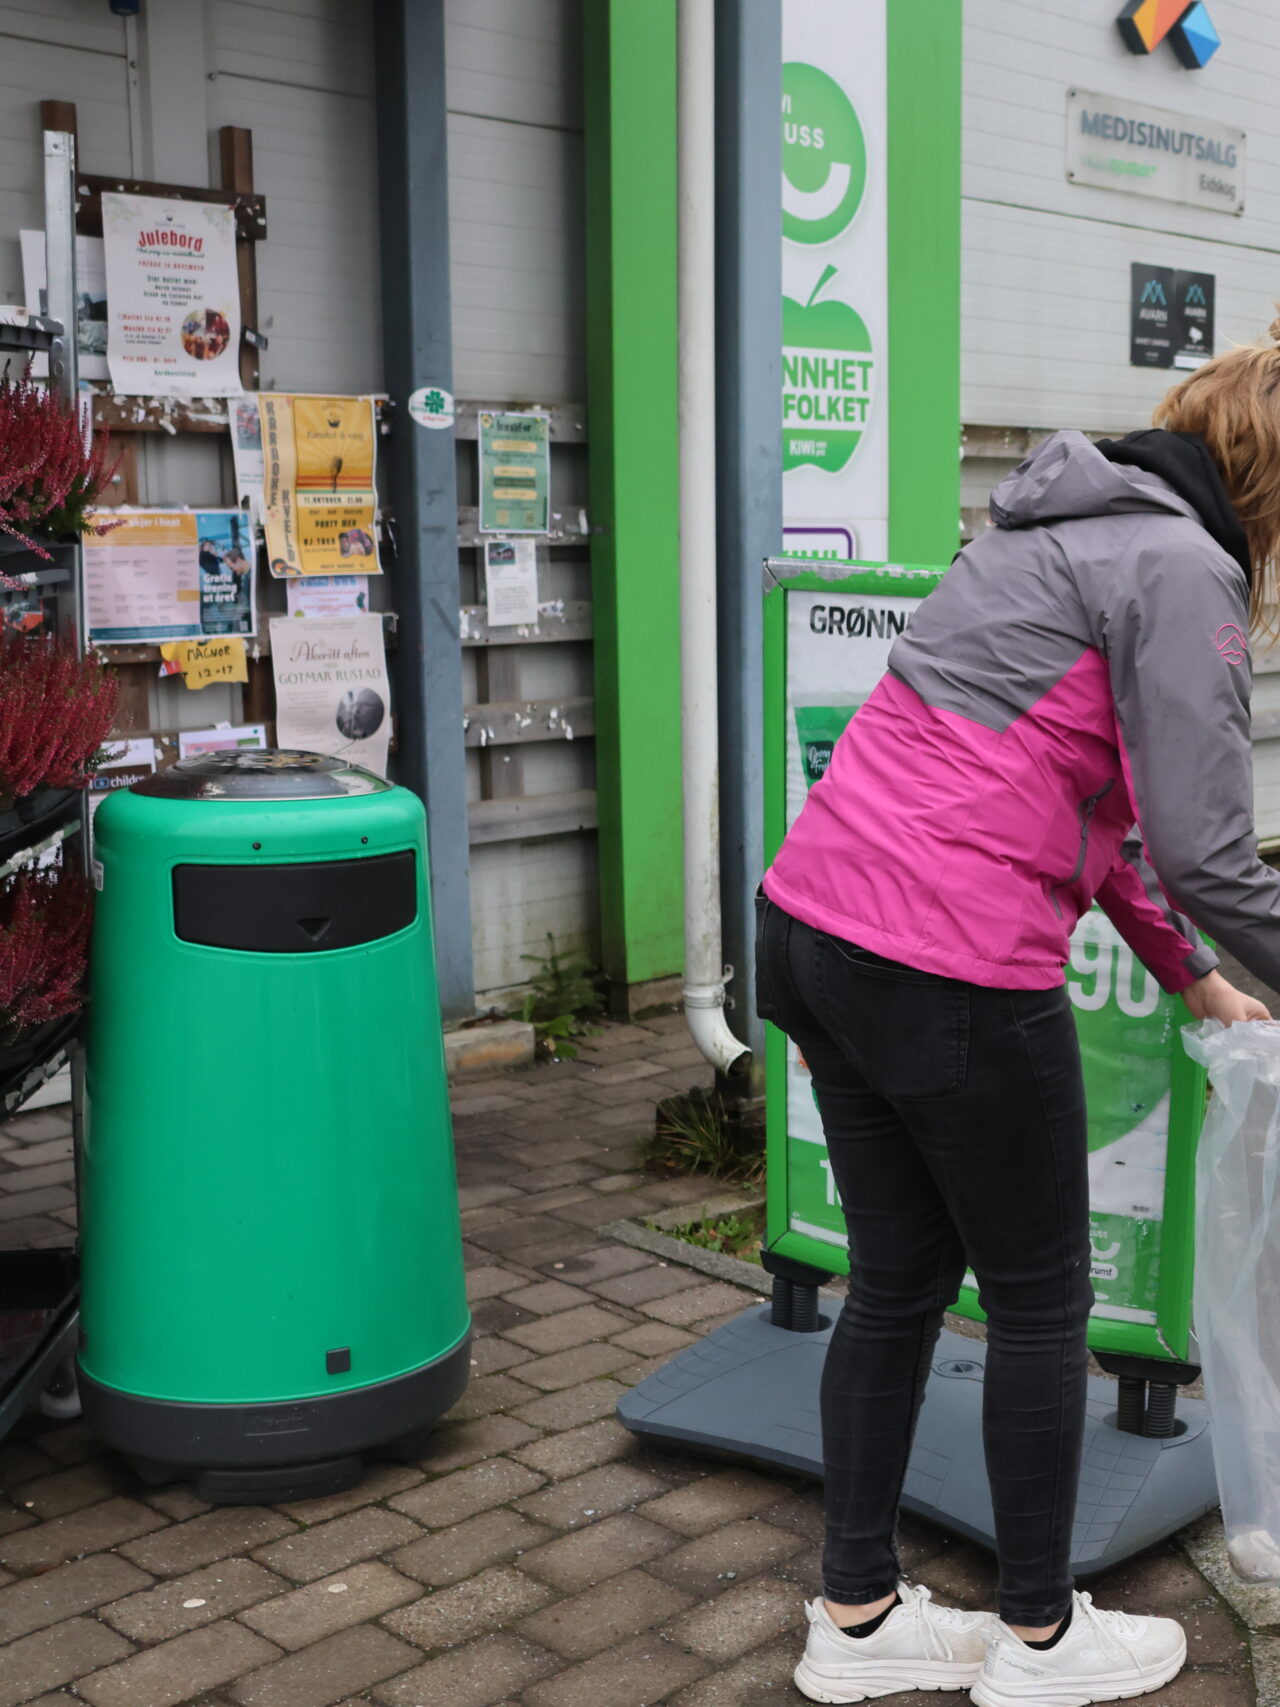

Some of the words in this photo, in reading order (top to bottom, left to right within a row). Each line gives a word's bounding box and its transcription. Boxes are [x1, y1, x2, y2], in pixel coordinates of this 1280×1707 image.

[784, 122, 824, 149] USS
[1081, 110, 1237, 168] MEDISINUTSALG
[1200, 173, 1236, 201] Eidskog
[138, 230, 203, 253] Julebord
[782, 355, 874, 392] NNHET
[783, 393, 870, 423] FOLKET
[790, 439, 816, 456] KIWI
[809, 604, 913, 640] GRØNN
[187, 645, 231, 661] MAGNOR
[335, 667, 382, 684] RUSTAD
[1067, 935, 1160, 1018] 90
[819, 1159, 843, 1207] 1
[1090, 1266, 1113, 1277] rumf
